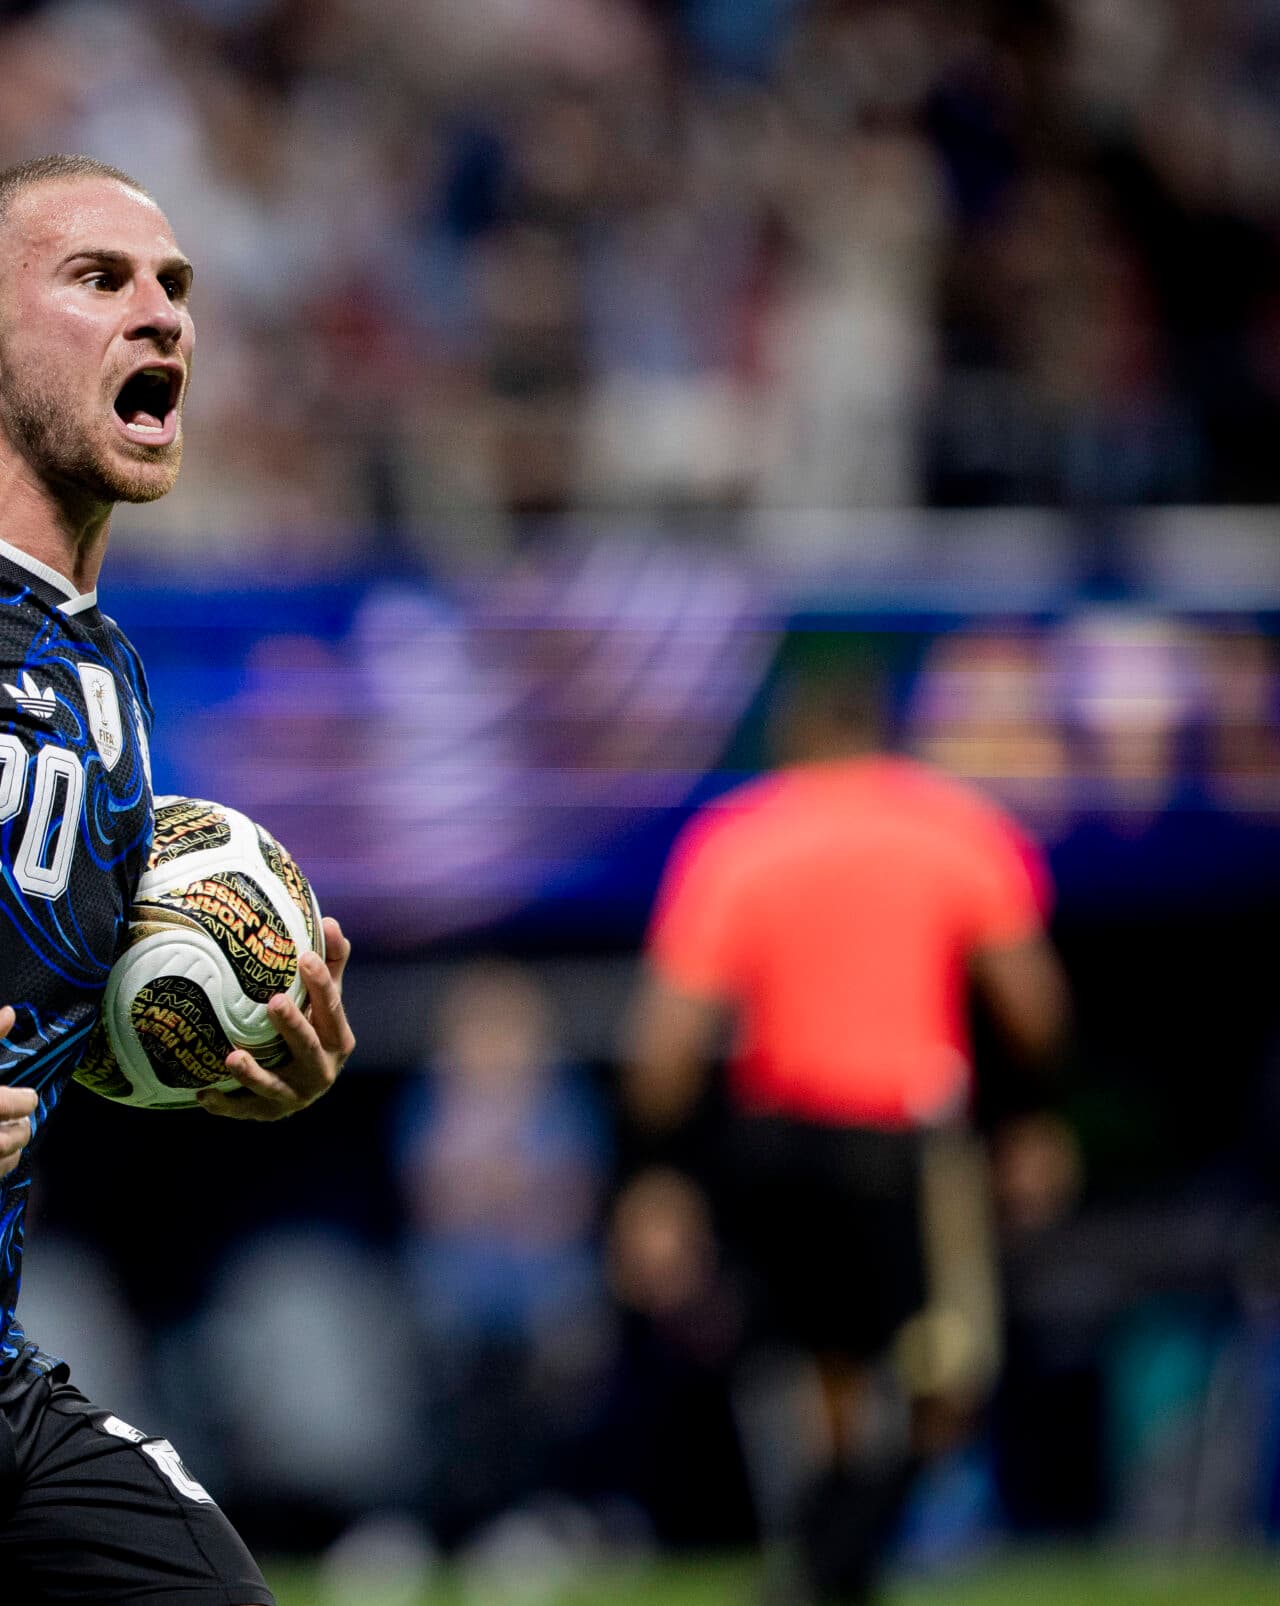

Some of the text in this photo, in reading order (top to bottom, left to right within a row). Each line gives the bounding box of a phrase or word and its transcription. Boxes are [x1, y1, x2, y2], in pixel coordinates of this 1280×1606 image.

[99, 729, 115, 746] FIFA
[187, 880, 261, 928] JERSEY
[245, 934, 291, 972] NEW
[143, 1005, 198, 1043] NEW
[195, 1040, 231, 1075] YOR
